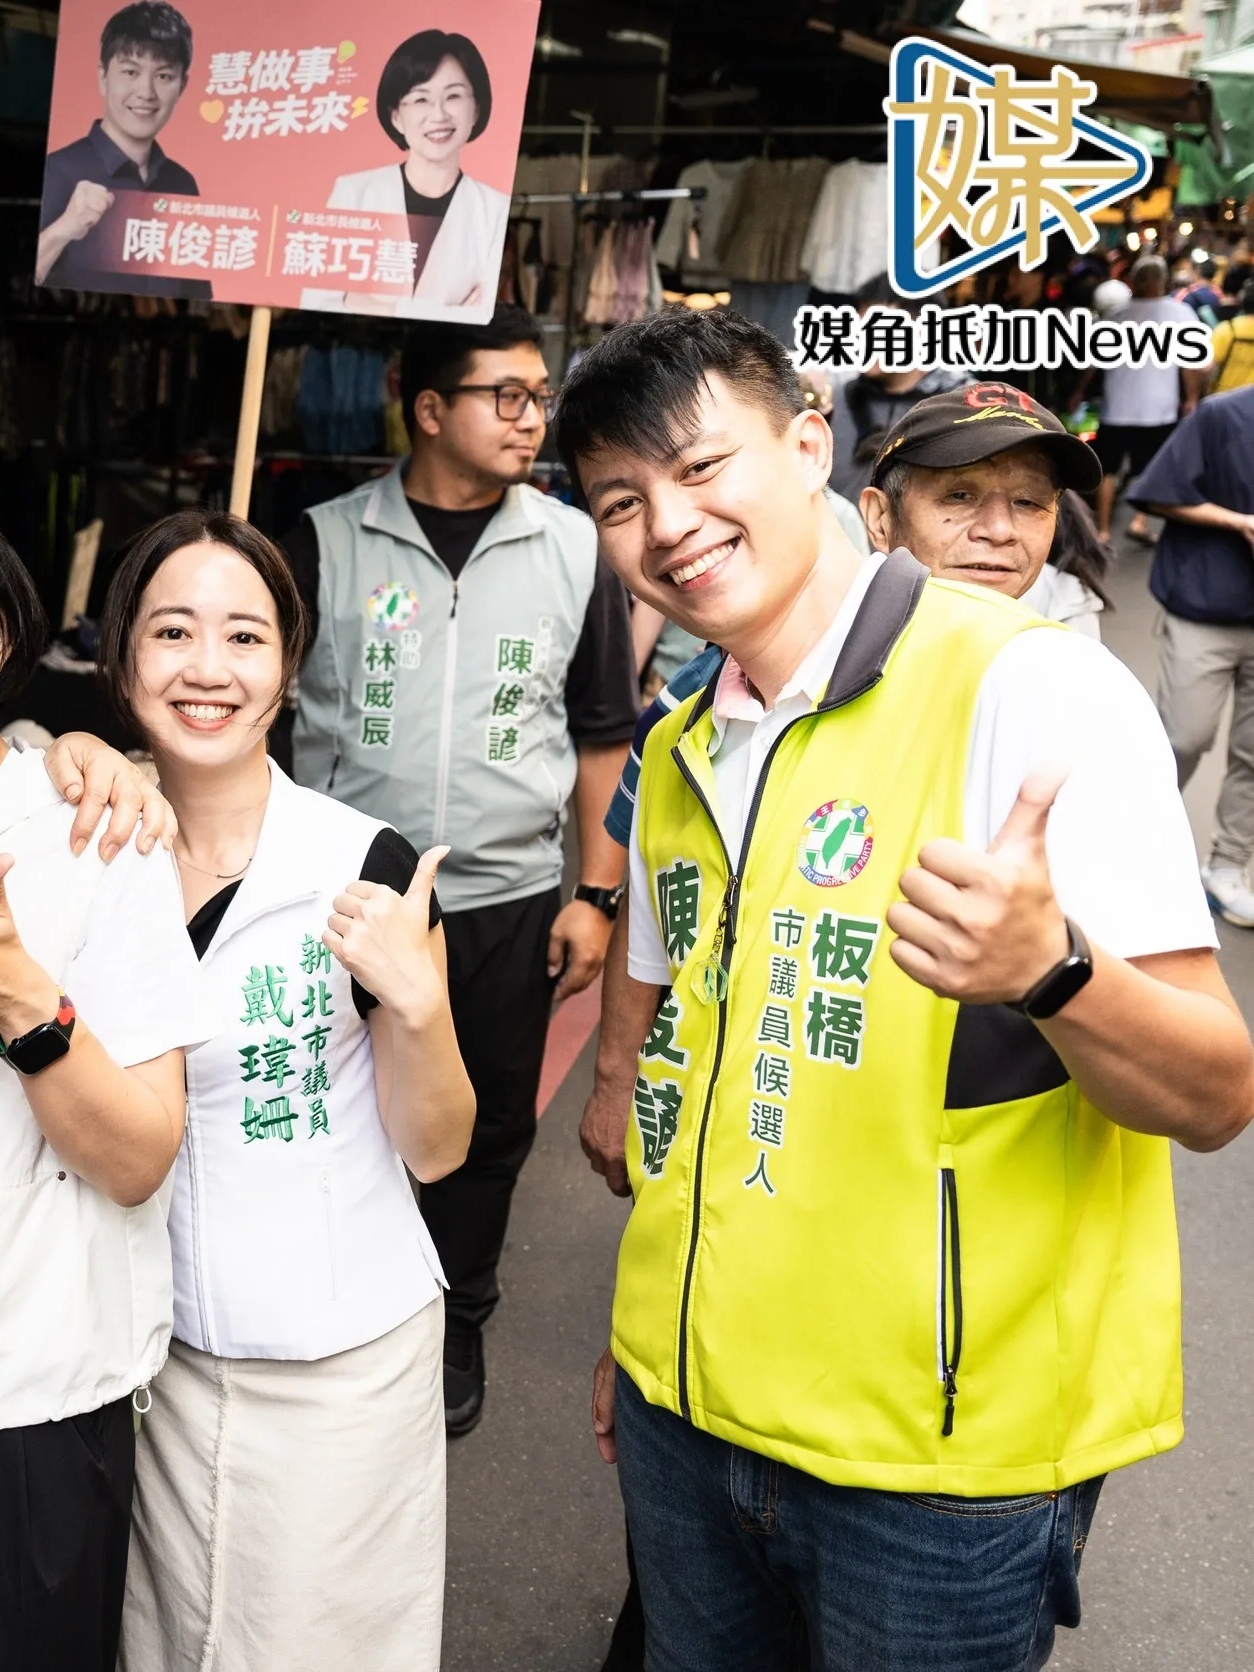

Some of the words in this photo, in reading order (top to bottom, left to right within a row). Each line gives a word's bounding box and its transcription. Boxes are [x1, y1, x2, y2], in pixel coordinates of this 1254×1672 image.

[205, 46, 337, 96] 慧做事
[122, 218, 258, 271] 陳俊諺
[169, 201, 261, 221] 新北市議員候選人
[282, 230, 419, 284] 蘇巧慧
[303, 212, 382, 232] 新北市長候選人
[362, 642, 396, 746] 林威辰
[488, 637, 535, 762] 陳俊諺
[299, 933, 335, 1140] 新北市議員
[806, 912, 878, 1066] 板橋
[238, 965, 299, 1144] 戴瑋姍
[744, 909, 806, 1195] 市議員候選人
